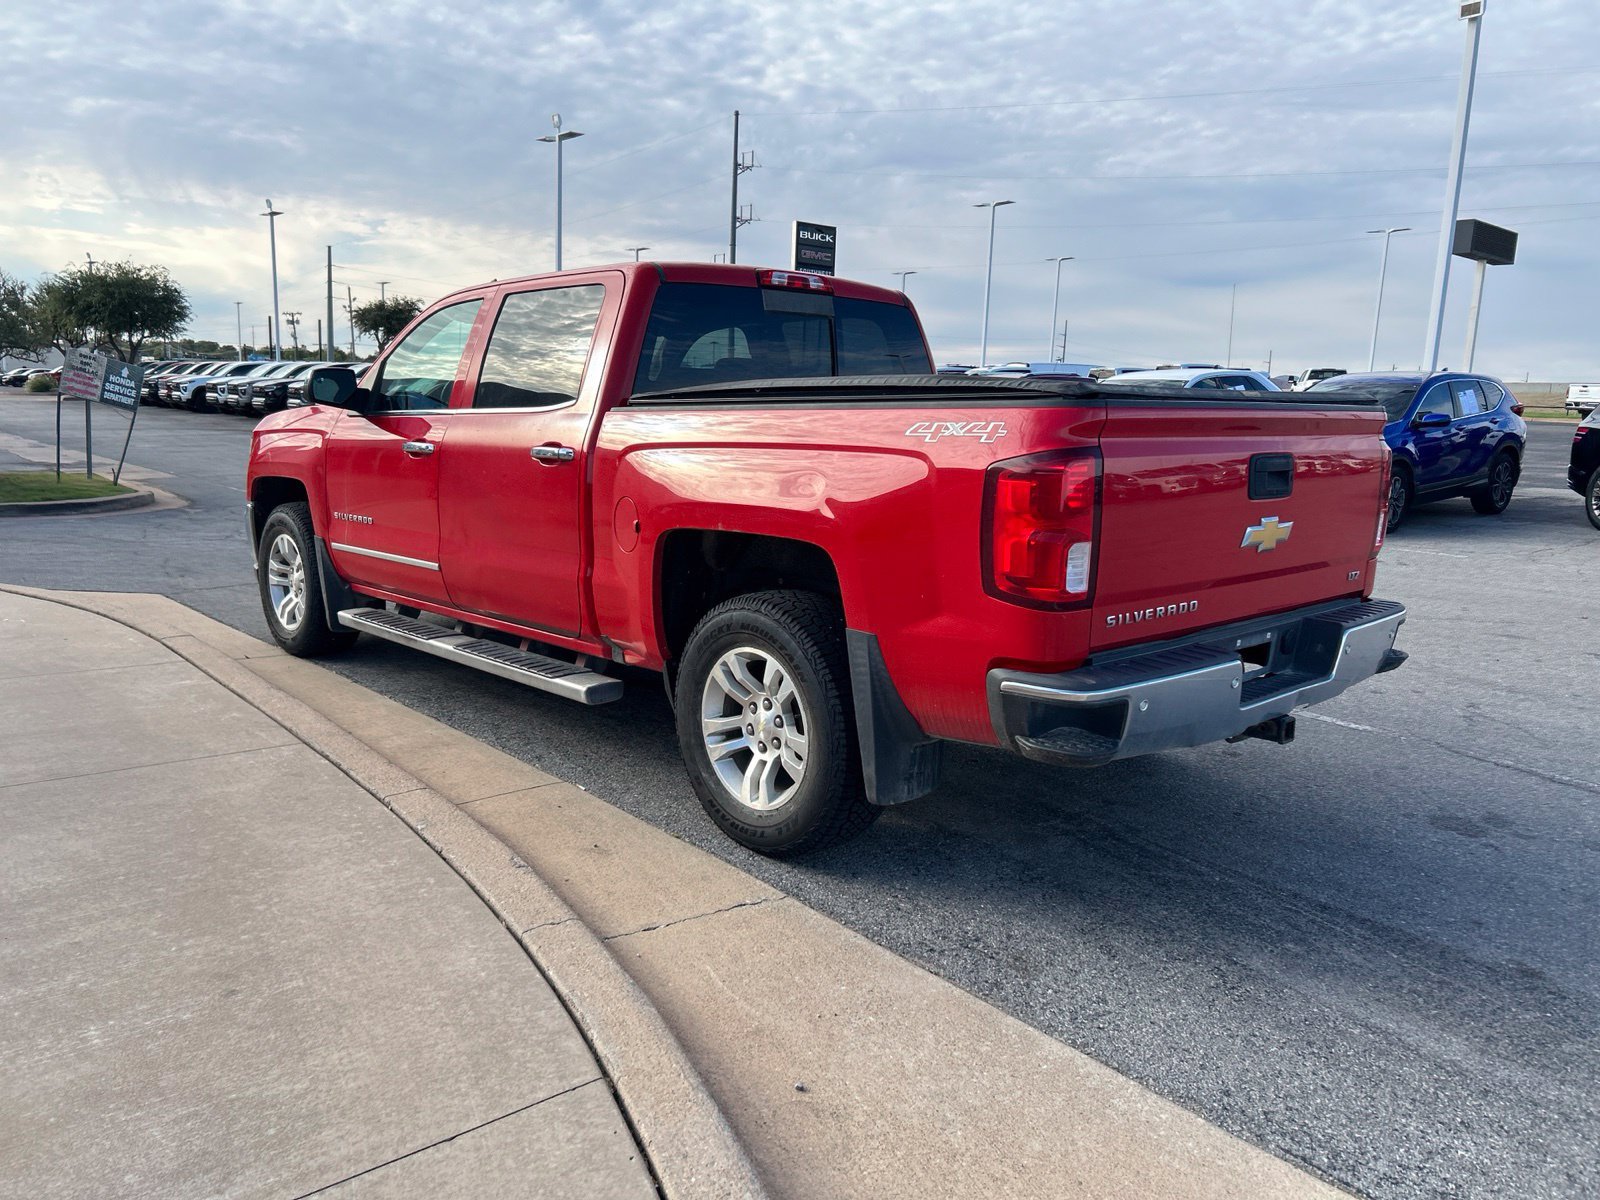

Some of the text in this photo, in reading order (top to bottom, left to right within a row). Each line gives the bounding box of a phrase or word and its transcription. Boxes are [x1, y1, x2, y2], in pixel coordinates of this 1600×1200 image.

[799, 230, 834, 242] BUICK
[801, 249, 832, 261] GMC
[109, 374, 136, 388] HONDA
[104, 382, 136, 398] SERVICE
[103, 391, 135, 406] DEPARTMENT
[333, 511, 373, 525] SILVERADO
[1347, 570, 1361, 581] LTZ
[1105, 600, 1199, 628] SILVERADO
